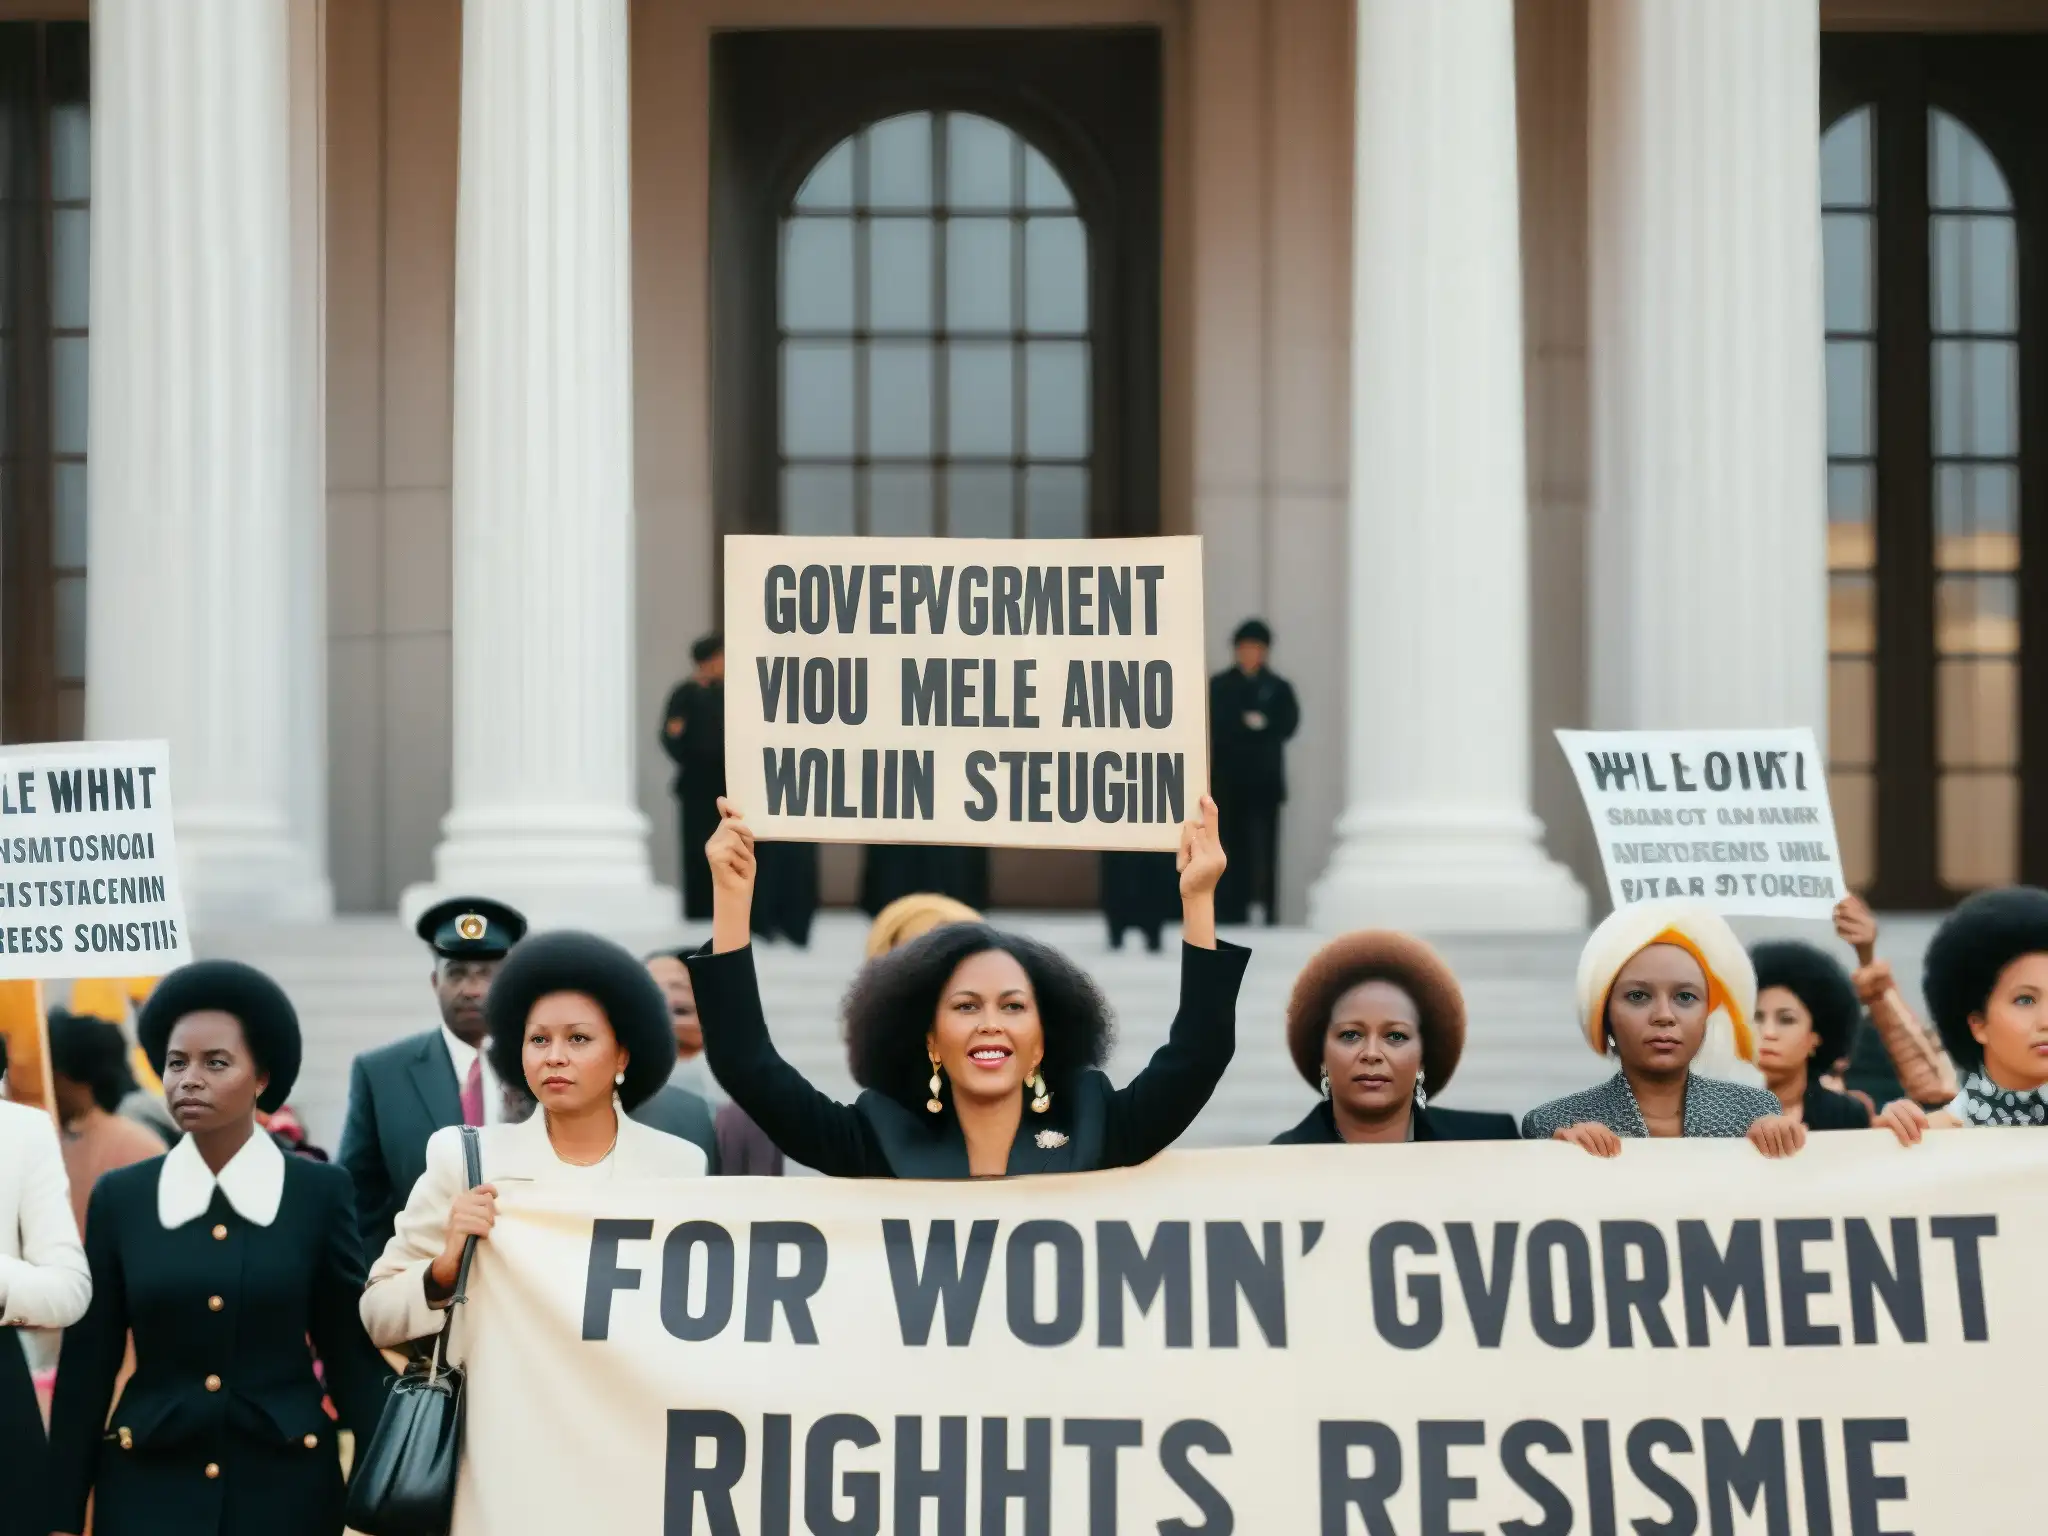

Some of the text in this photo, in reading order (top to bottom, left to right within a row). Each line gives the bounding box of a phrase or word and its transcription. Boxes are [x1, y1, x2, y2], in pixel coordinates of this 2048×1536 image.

[756, 656, 1173, 729] VIOU MELE AINO
[47, 767, 156, 813] WHNT
[582, 1219, 828, 1345] FOR
[1368, 1214, 1998, 1350] GVORMENT
[664, 1409, 1915, 1536] RIGHHTS RESISMIE
